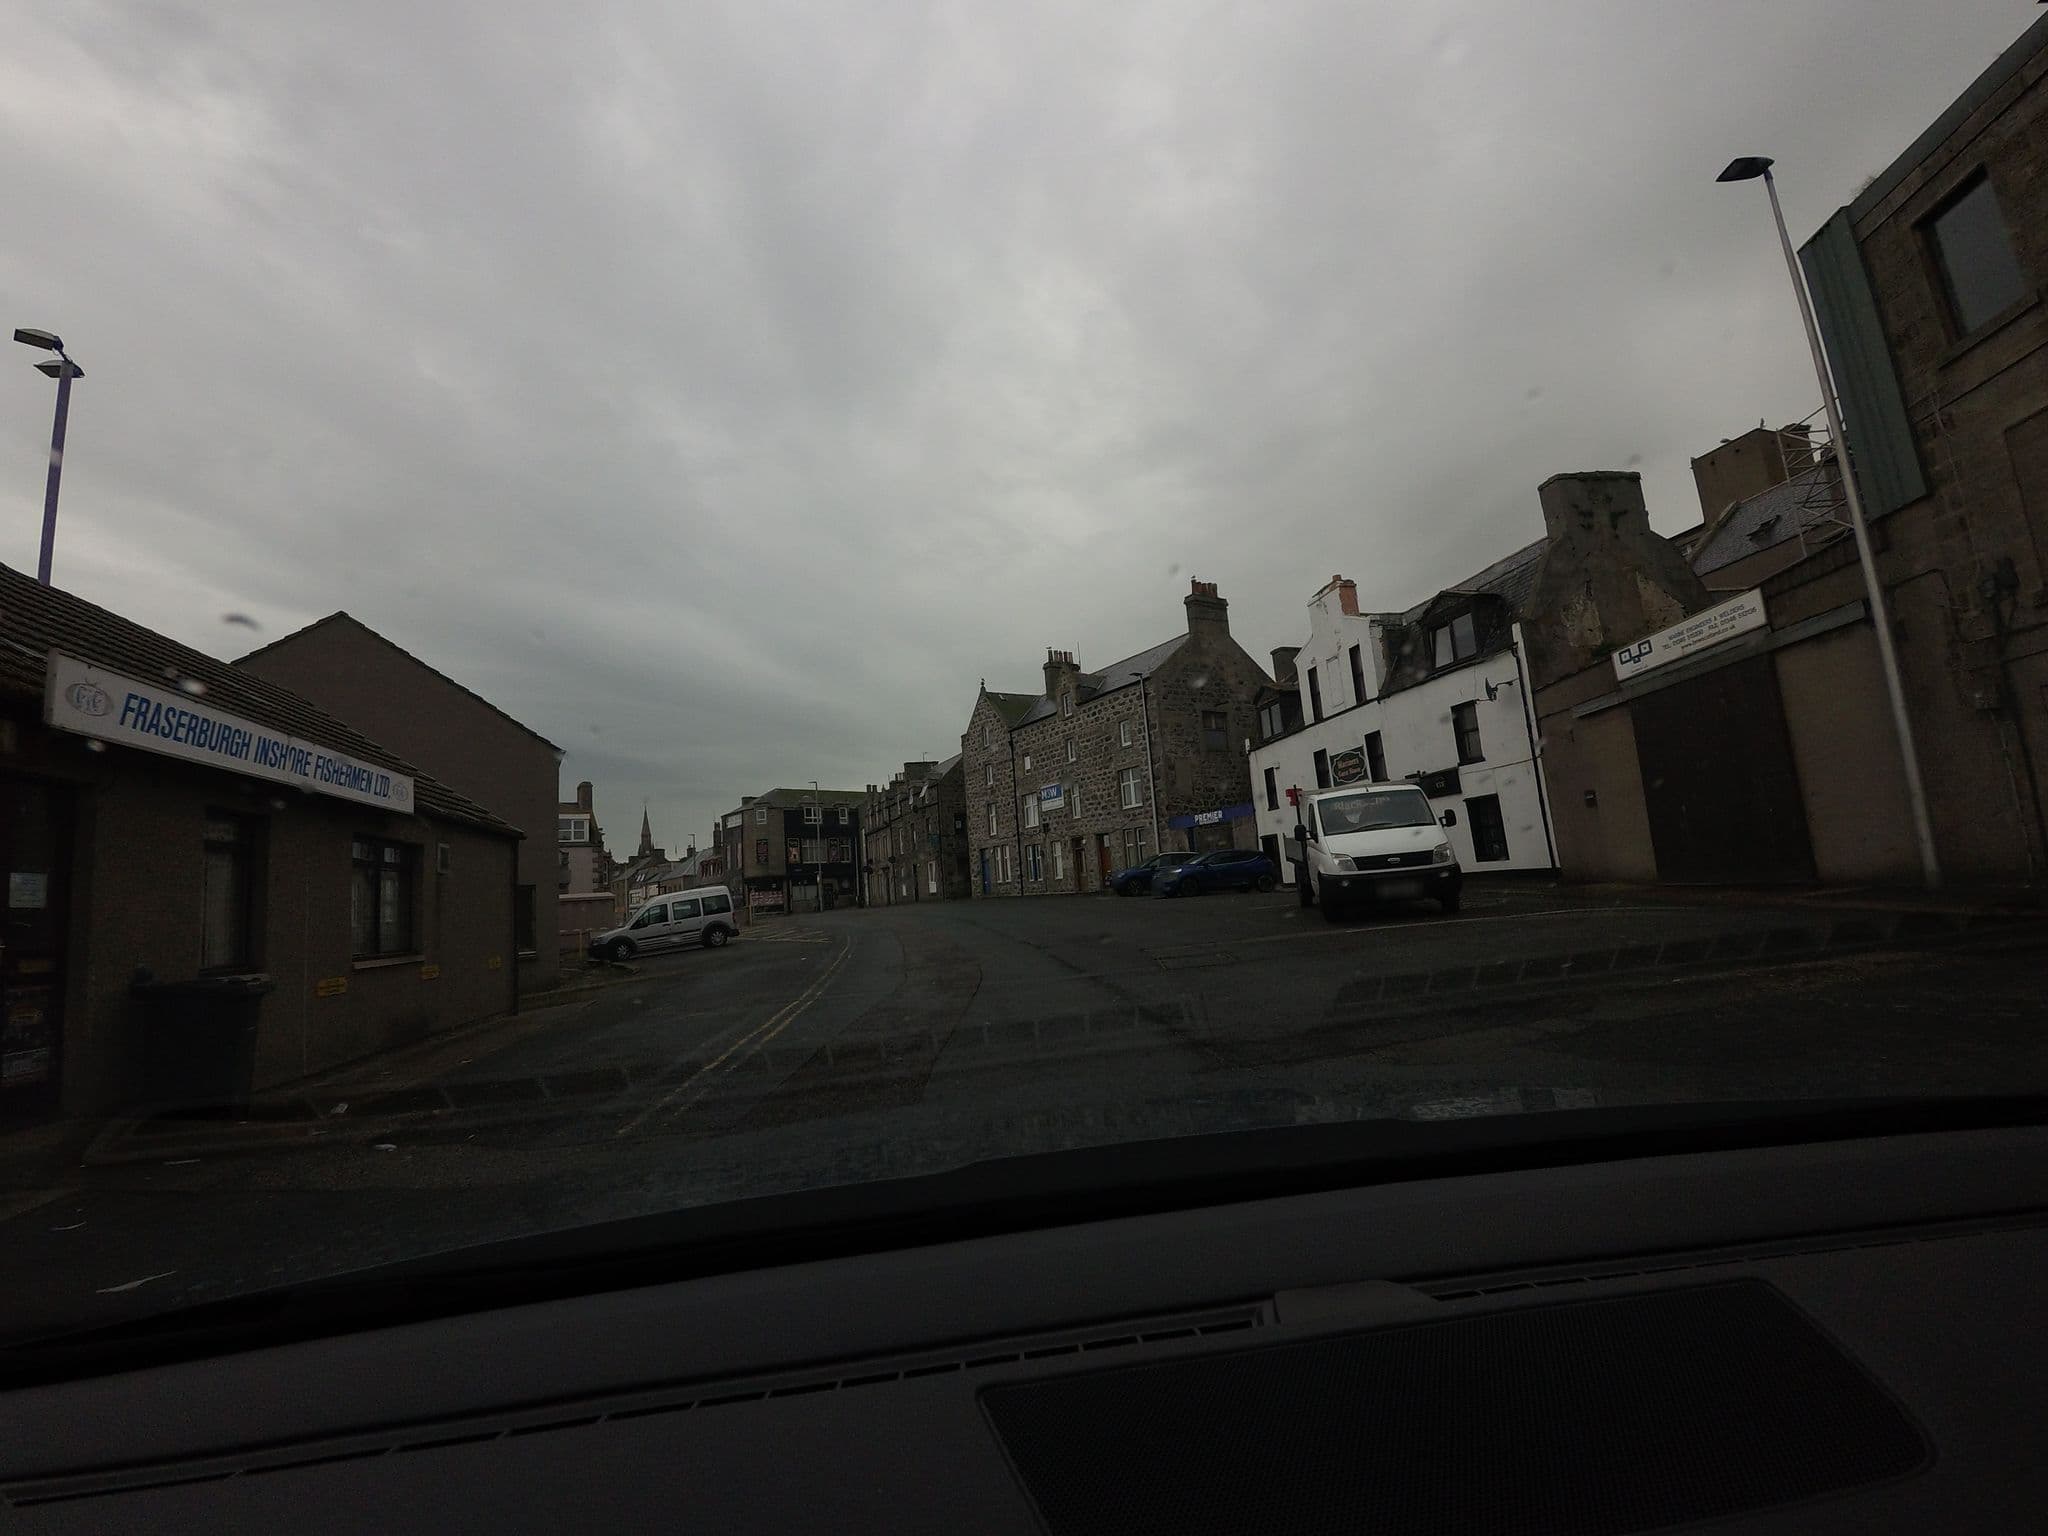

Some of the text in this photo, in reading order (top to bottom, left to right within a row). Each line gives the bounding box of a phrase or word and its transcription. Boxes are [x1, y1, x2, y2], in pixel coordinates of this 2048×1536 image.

[119, 692, 253, 763] FRASERBURGH
[253, 735, 312, 779] INSHORE
[313, 754, 373, 793] FISHERMEN
[1194, 810, 1223, 824] PREMIER
